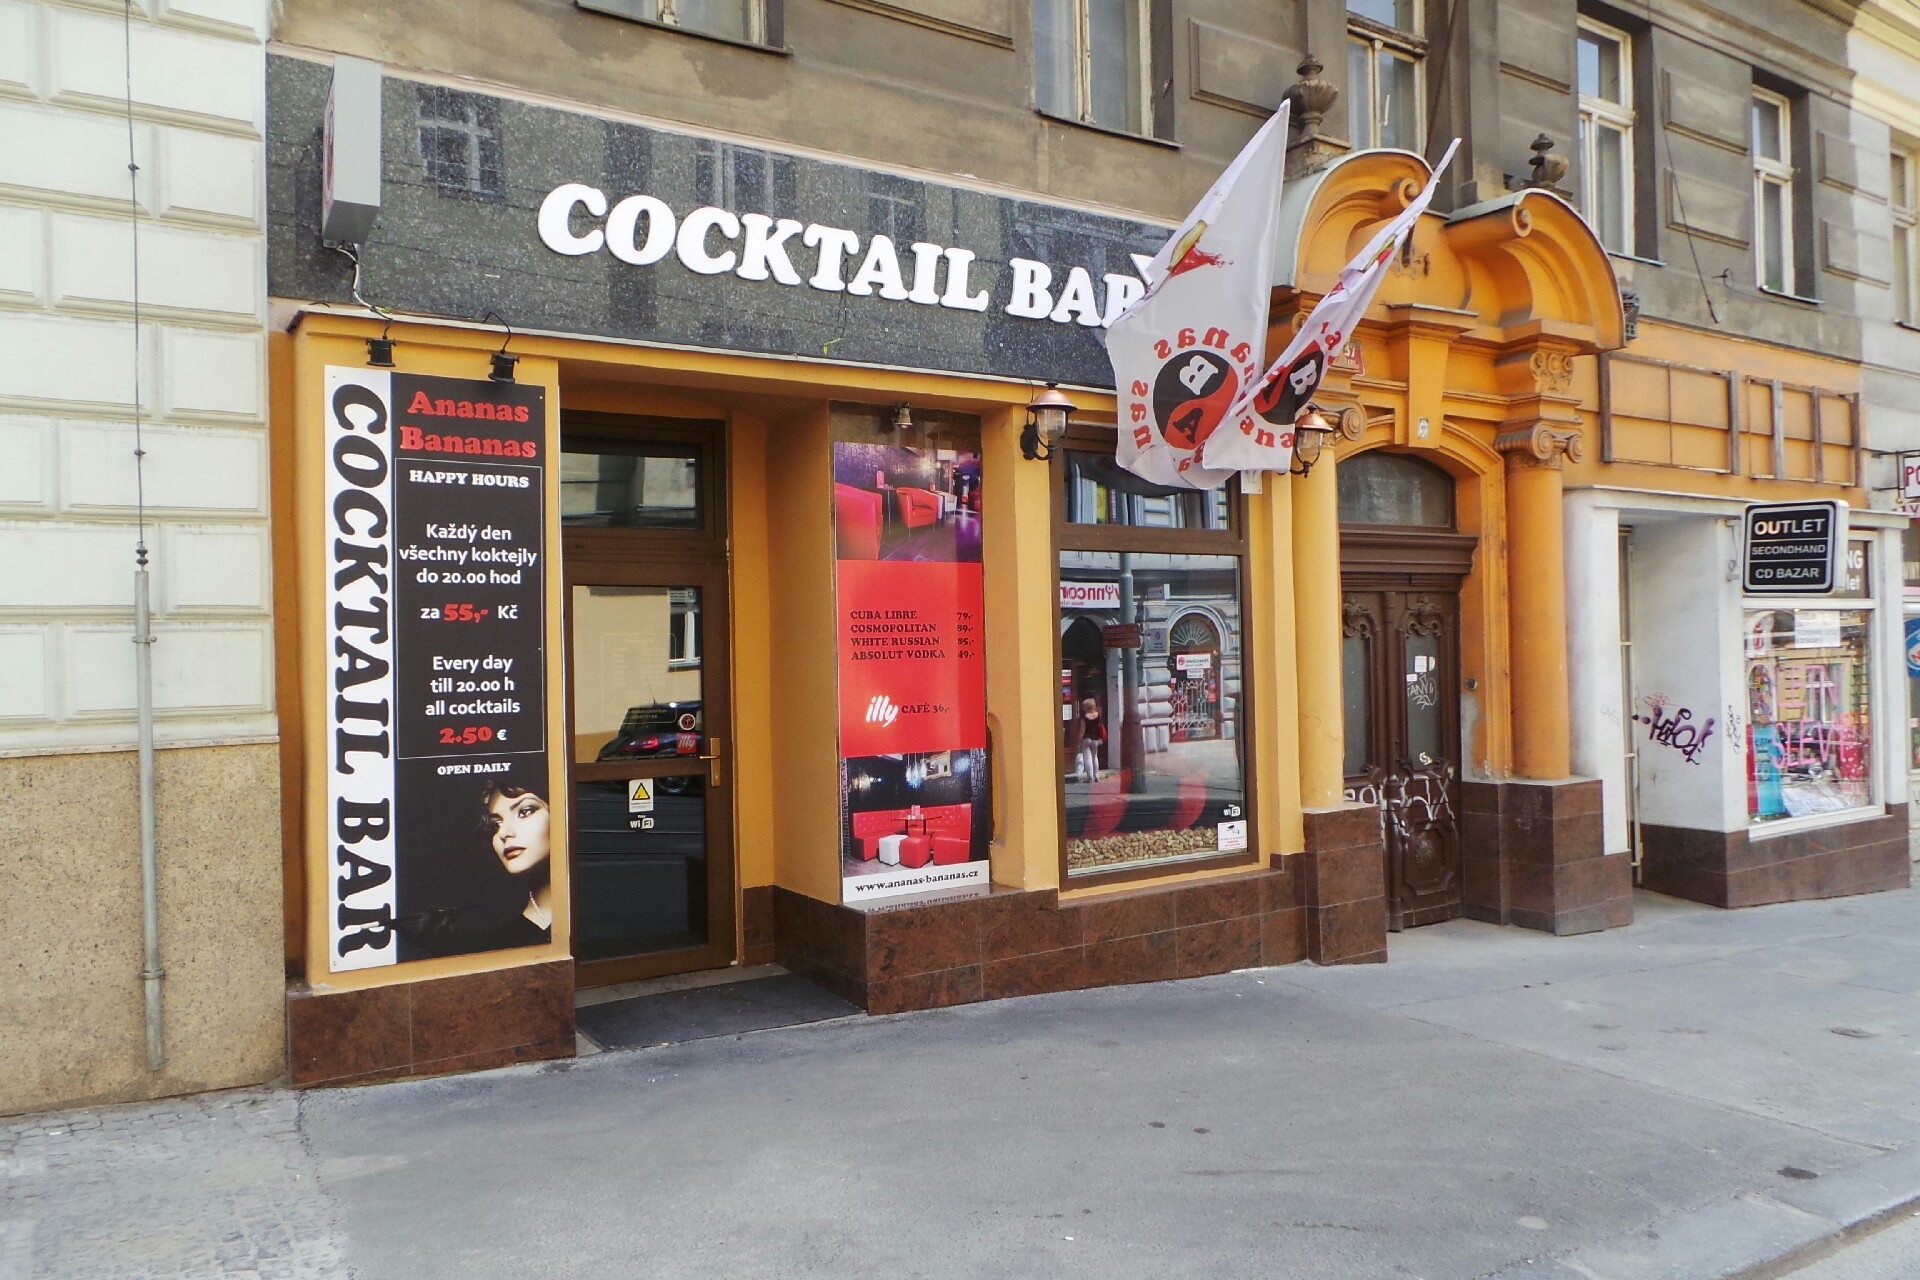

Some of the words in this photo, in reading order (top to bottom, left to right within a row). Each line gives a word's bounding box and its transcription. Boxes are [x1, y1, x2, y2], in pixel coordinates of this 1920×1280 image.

[537, 182, 988, 312] COCKTAIL
[407, 391, 529, 422] Ananas
[400, 426, 536, 458] Bananas
[409, 470, 468, 484] HAPPY
[471, 473, 529, 488] HOURS
[426, 523, 477, 543] Každý
[481, 525, 512, 540] den
[1754, 519, 1826, 535] OUTLET
[399, 545, 468, 565] všechny
[471, 547, 537, 567] koktejly
[1751, 545, 1826, 555] SECONDHAND
[332, 384, 390, 775] COCKTAIL
[416, 568, 438, 583] do
[442, 572, 486, 584] 20.00
[490, 569, 521, 584] hod
[1755, 569, 1773, 579] CD
[1776, 568, 1819, 579] BAZAR
[420, 607, 440, 619] za
[497, 605, 518, 619] Kč
[850, 611, 881, 620] CUBA
[885, 611, 917, 620] LIBRE
[850, 624, 937, 633] COSMOPOLITAN
[851, 637, 889, 646] WHITE
[891, 637, 940, 646] RUSSIAN
[432, 656, 479, 673] Every
[482, 655, 513, 673] day
[851, 651, 904, 660] ABSOLUT
[906, 650, 945, 659] VODKA
[430, 678, 452, 693] till
[456, 680, 500, 692] 20.00
[504, 677, 515, 691] h
[425, 700, 445, 716] all
[449, 698, 521, 715] cocktails
[865, 695, 899, 728] illy
[440, 726, 493, 744] 2.50
[496, 729, 507, 740] €
[437, 764, 471, 775] OPEN
[473, 762, 512, 773] DAILY
[336, 796, 393, 958] BAR
[855, 870, 980, 893] www.ananas-bananas.cz
